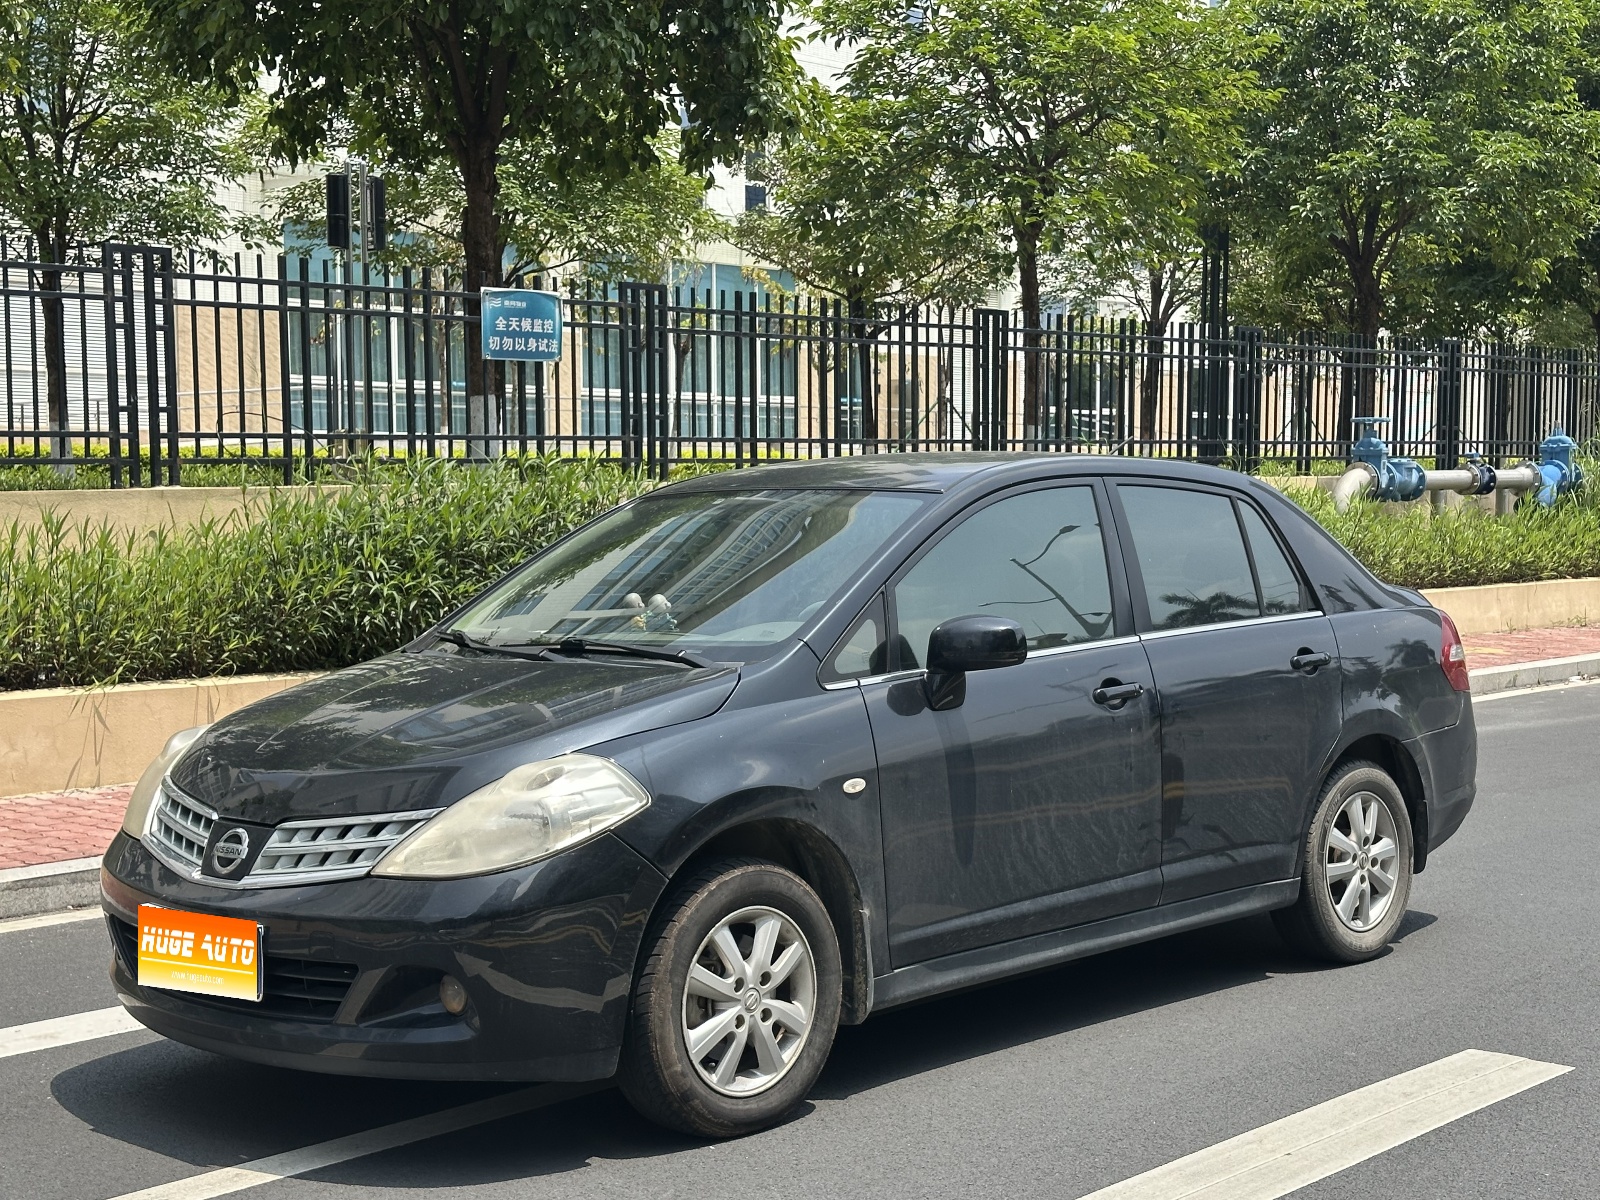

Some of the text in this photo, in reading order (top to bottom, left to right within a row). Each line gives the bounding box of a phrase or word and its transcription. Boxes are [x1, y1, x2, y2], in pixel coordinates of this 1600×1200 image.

[495, 316, 554, 333] 全天候监控
[488, 336, 559, 353] 切勿以身试法
[215, 845, 243, 856] NISSAN
